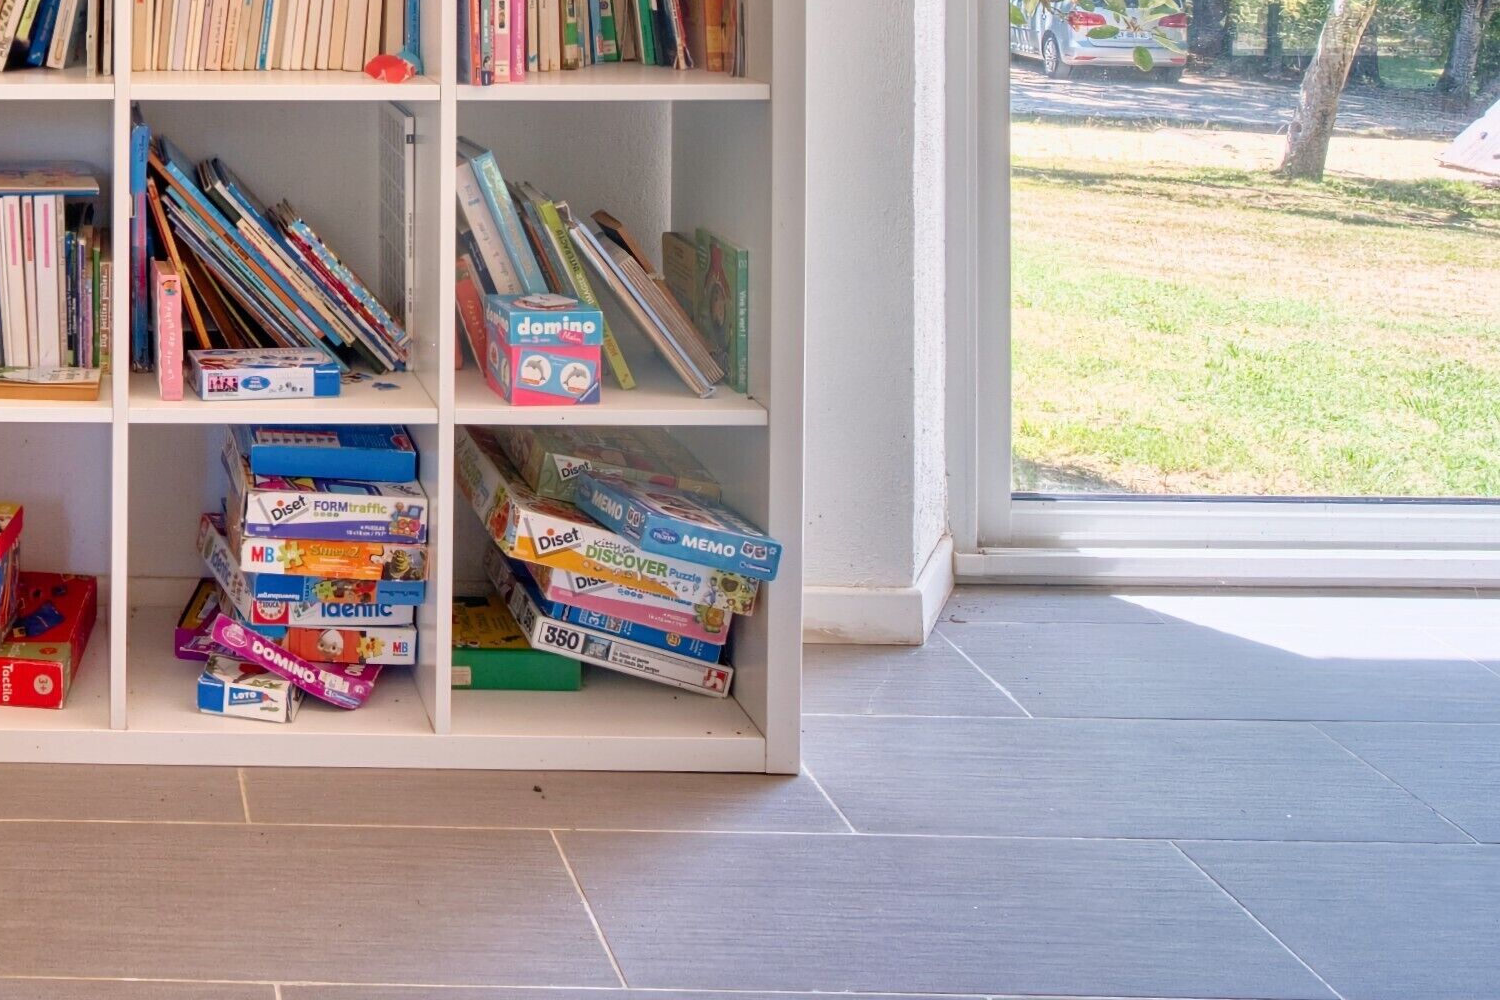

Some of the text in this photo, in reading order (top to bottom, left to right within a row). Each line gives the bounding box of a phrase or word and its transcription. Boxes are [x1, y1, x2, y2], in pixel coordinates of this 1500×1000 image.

[739, 307, 746, 315] le
[518, 316, 596, 335] domino
[738, 316, 746, 332] vert
[561, 461, 592, 478] Diset
[271, 495, 306, 521] Diset
[313, 500, 388, 514] FORMtraffic
[591, 491, 623, 520] MEMO
[538, 528, 580, 550] Diset
[593, 539, 615, 553] Kitty
[682, 534, 736, 557] MEMO
[251, 546, 274, 563] MB
[585, 545, 702, 584] DISCOVER Puzzle
[256, 591, 300, 600] Ravensburger
[544, 625, 580, 650] 350
[393, 641, 409, 652] MB
[253, 640, 316, 683] DOMINO
[2, 663, 14, 702] Tactilo
[38, 677, 48, 692] 3+
[232, 691, 257, 700] LOTO
